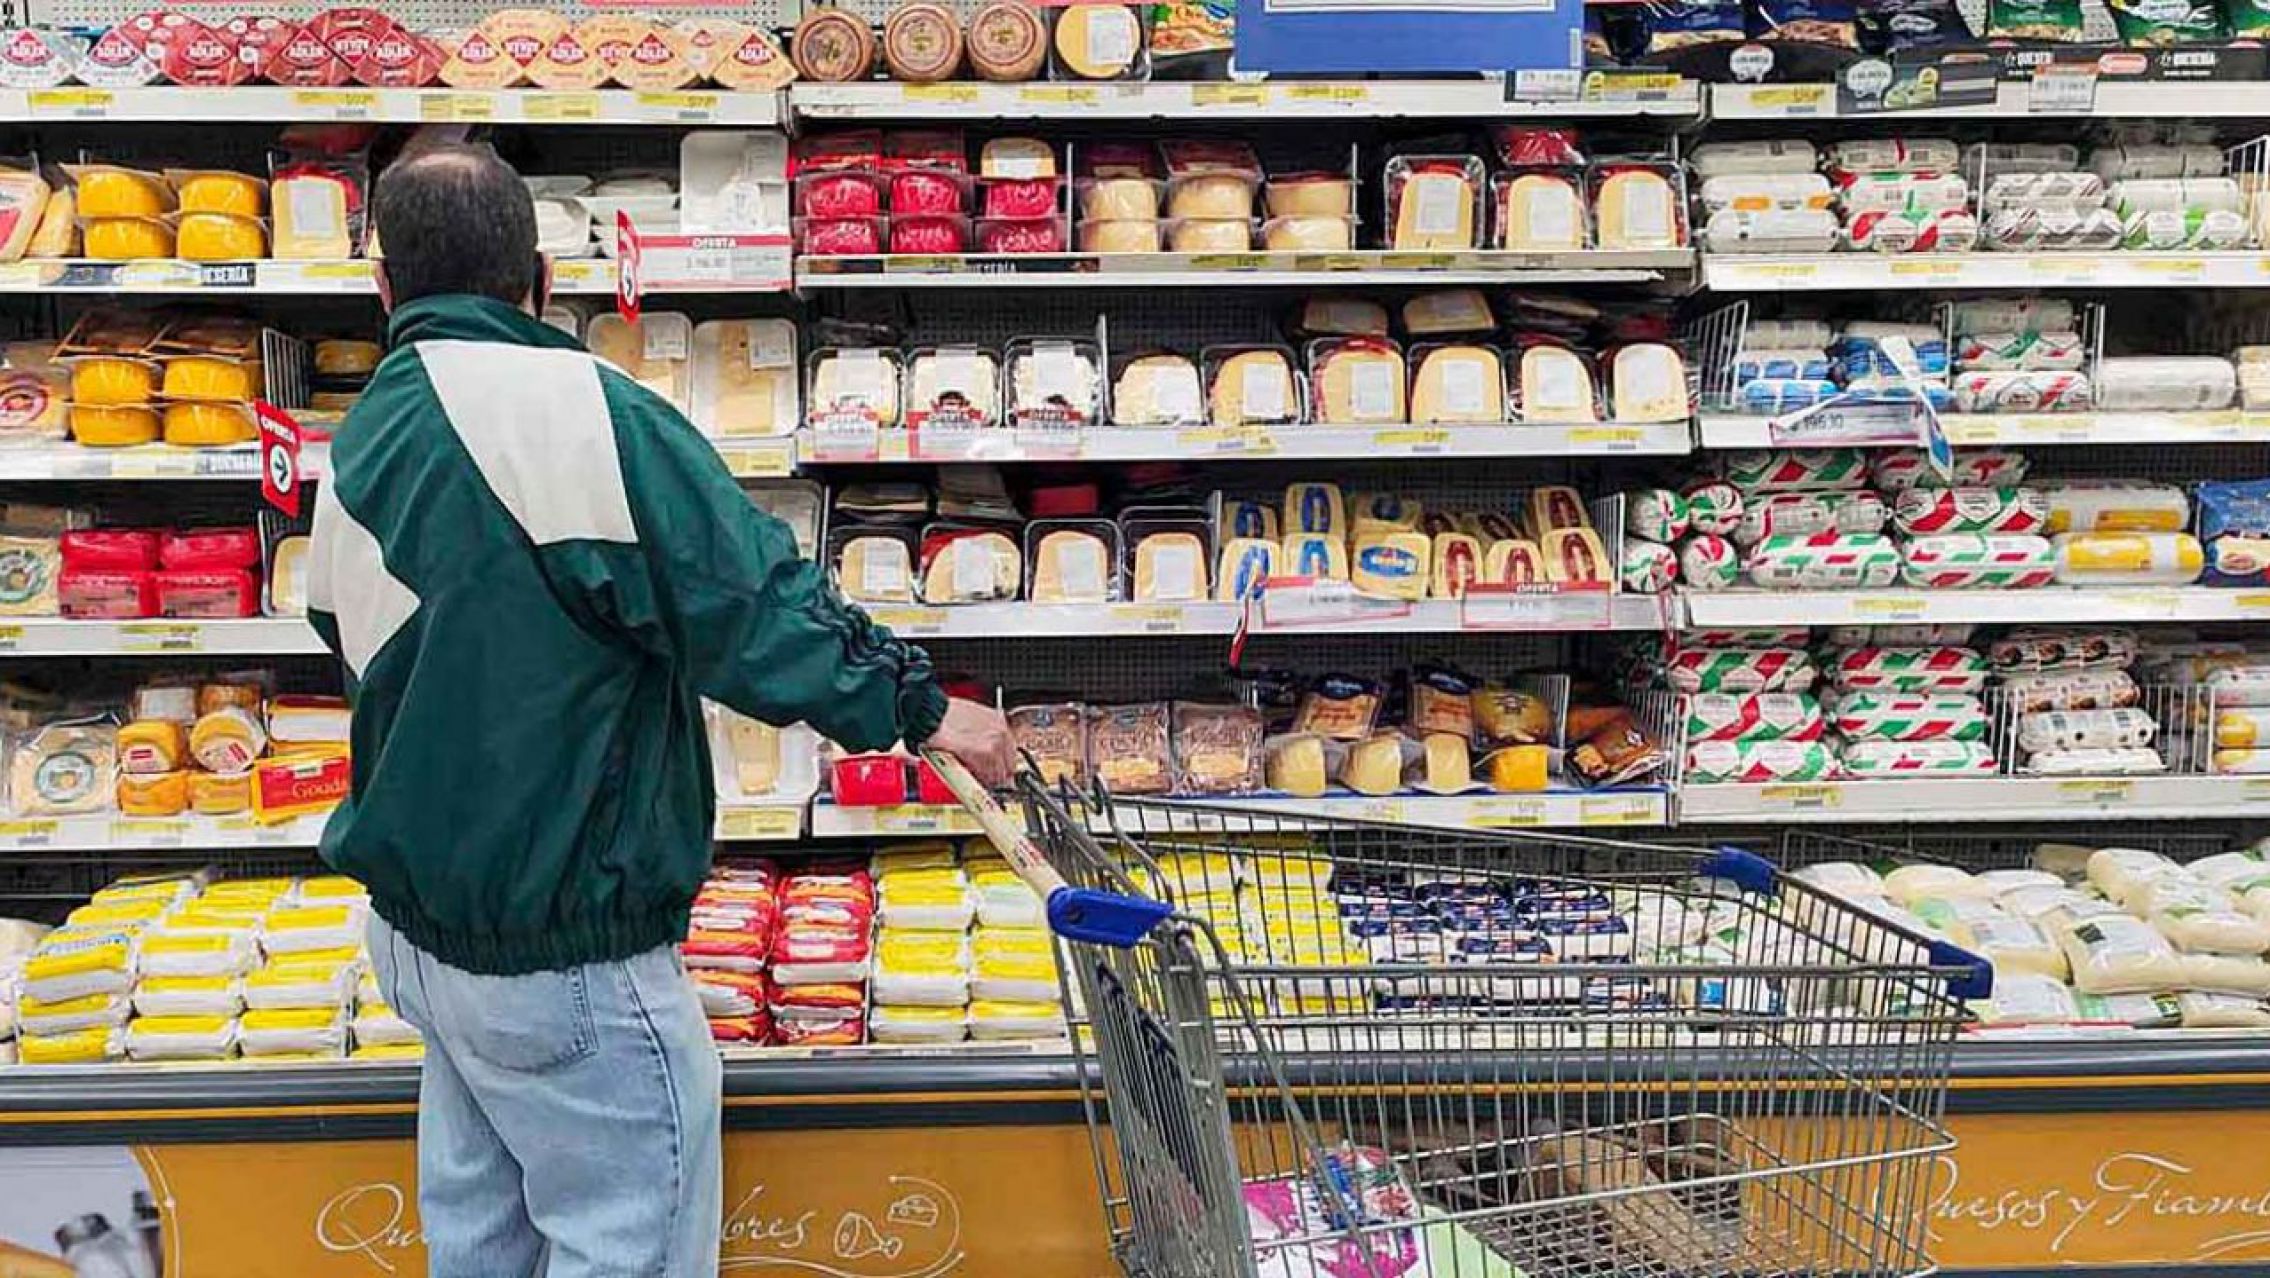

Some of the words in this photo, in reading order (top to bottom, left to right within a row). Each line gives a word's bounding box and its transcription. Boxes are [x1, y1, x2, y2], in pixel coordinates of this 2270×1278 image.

[692, 237, 738, 249] OFERTA
[722, 1185, 816, 1247] bres
[2050, 1197, 2098, 1253] y
[2096, 1152, 2270, 1227] Fiam
